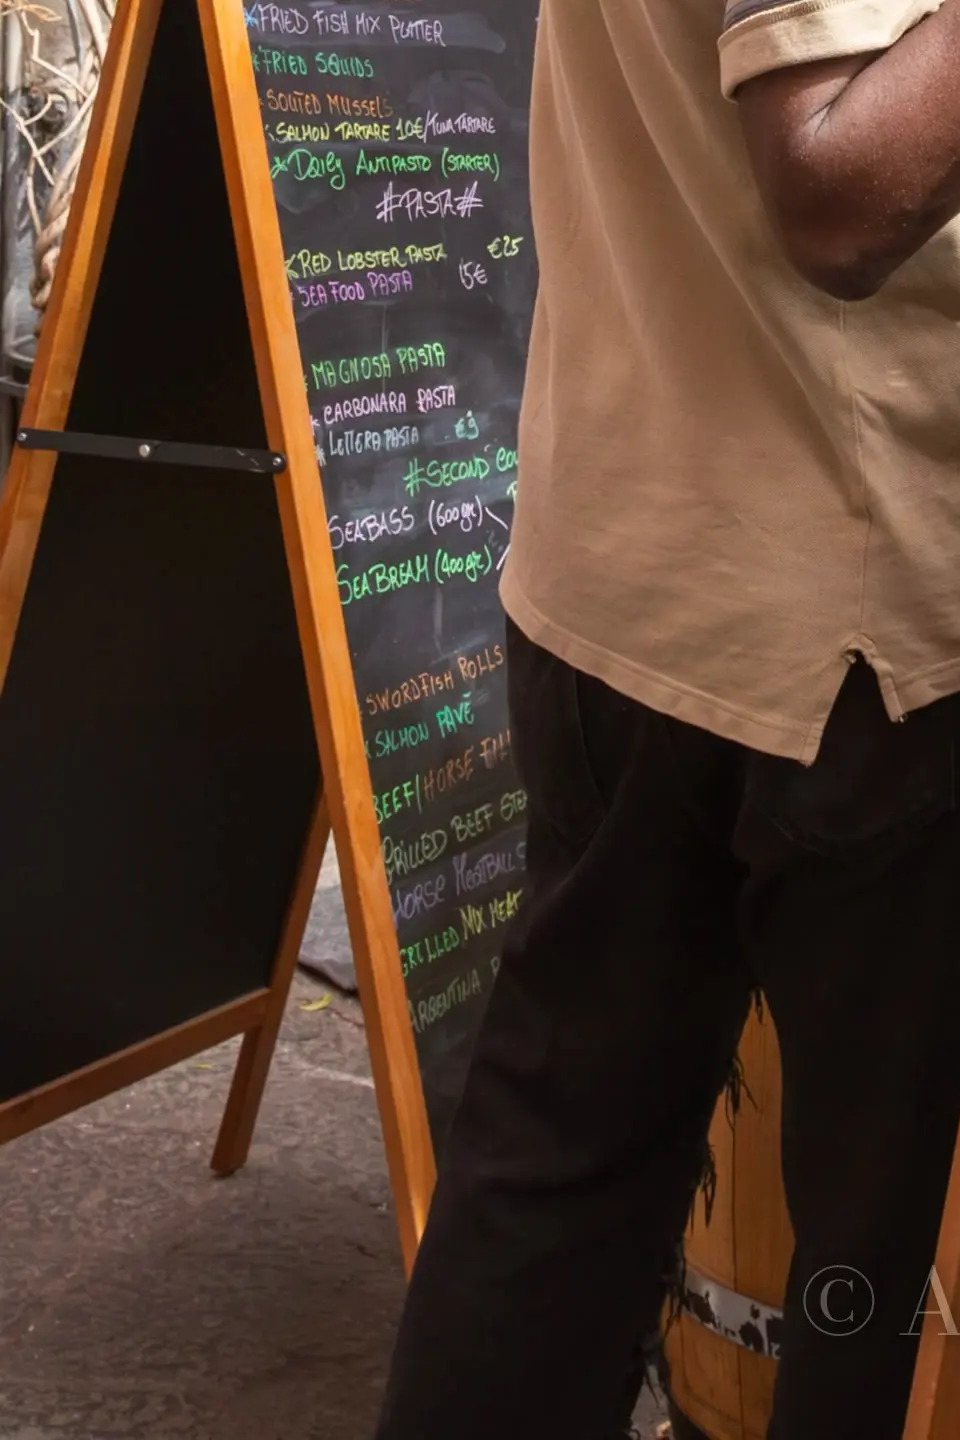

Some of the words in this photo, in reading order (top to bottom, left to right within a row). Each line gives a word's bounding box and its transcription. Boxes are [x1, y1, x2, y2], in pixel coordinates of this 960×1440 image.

[258, 3, 309, 35] FRIED
[312, 10, 349, 36] FISH
[356, 12, 381, 35] MIX
[388, 14, 446, 47] PLATTER
[259, 46, 307, 75] FRIED
[315, 52, 374, 78] SQUIDS
[266, 88, 321, 115] SOUTED
[276, 122, 330, 143] SALMON
[334, 122, 390, 142] TARTARE
[455, 112, 496, 134] TARTARE
[441, 147, 500, 182] (STARTER)
[298, 248, 331, 278] RED
[337, 248, 407, 271] LOBSTER
[404, 242, 448, 265] PASTA
[487, 235, 523, 259] €25
[298, 286, 328, 307] SEA
[328, 281, 365, 301] FOOD
[367, 269, 413, 297] PASTA
[311, 353, 391, 389] MAGNOSA
[396, 342, 446, 374] PASTA
[323, 391, 407, 425] CARBONARA
[416, 385, 456, 413] PASTA
[329, 430, 381, 457] LETTERA
[384, 426, 419, 451] PASTA
[365, 670, 454, 716] SWORDFISH
[457, 644, 504, 681] ROLLS
[375, 721, 429, 758] SALMON
[381, 829, 447, 885] GRILLED
[451, 803, 493, 843] BEEF
[391, 874, 445, 926] HORSE
[400, 926, 461, 976] GRILLED
[460, 904, 487, 940] MIX
